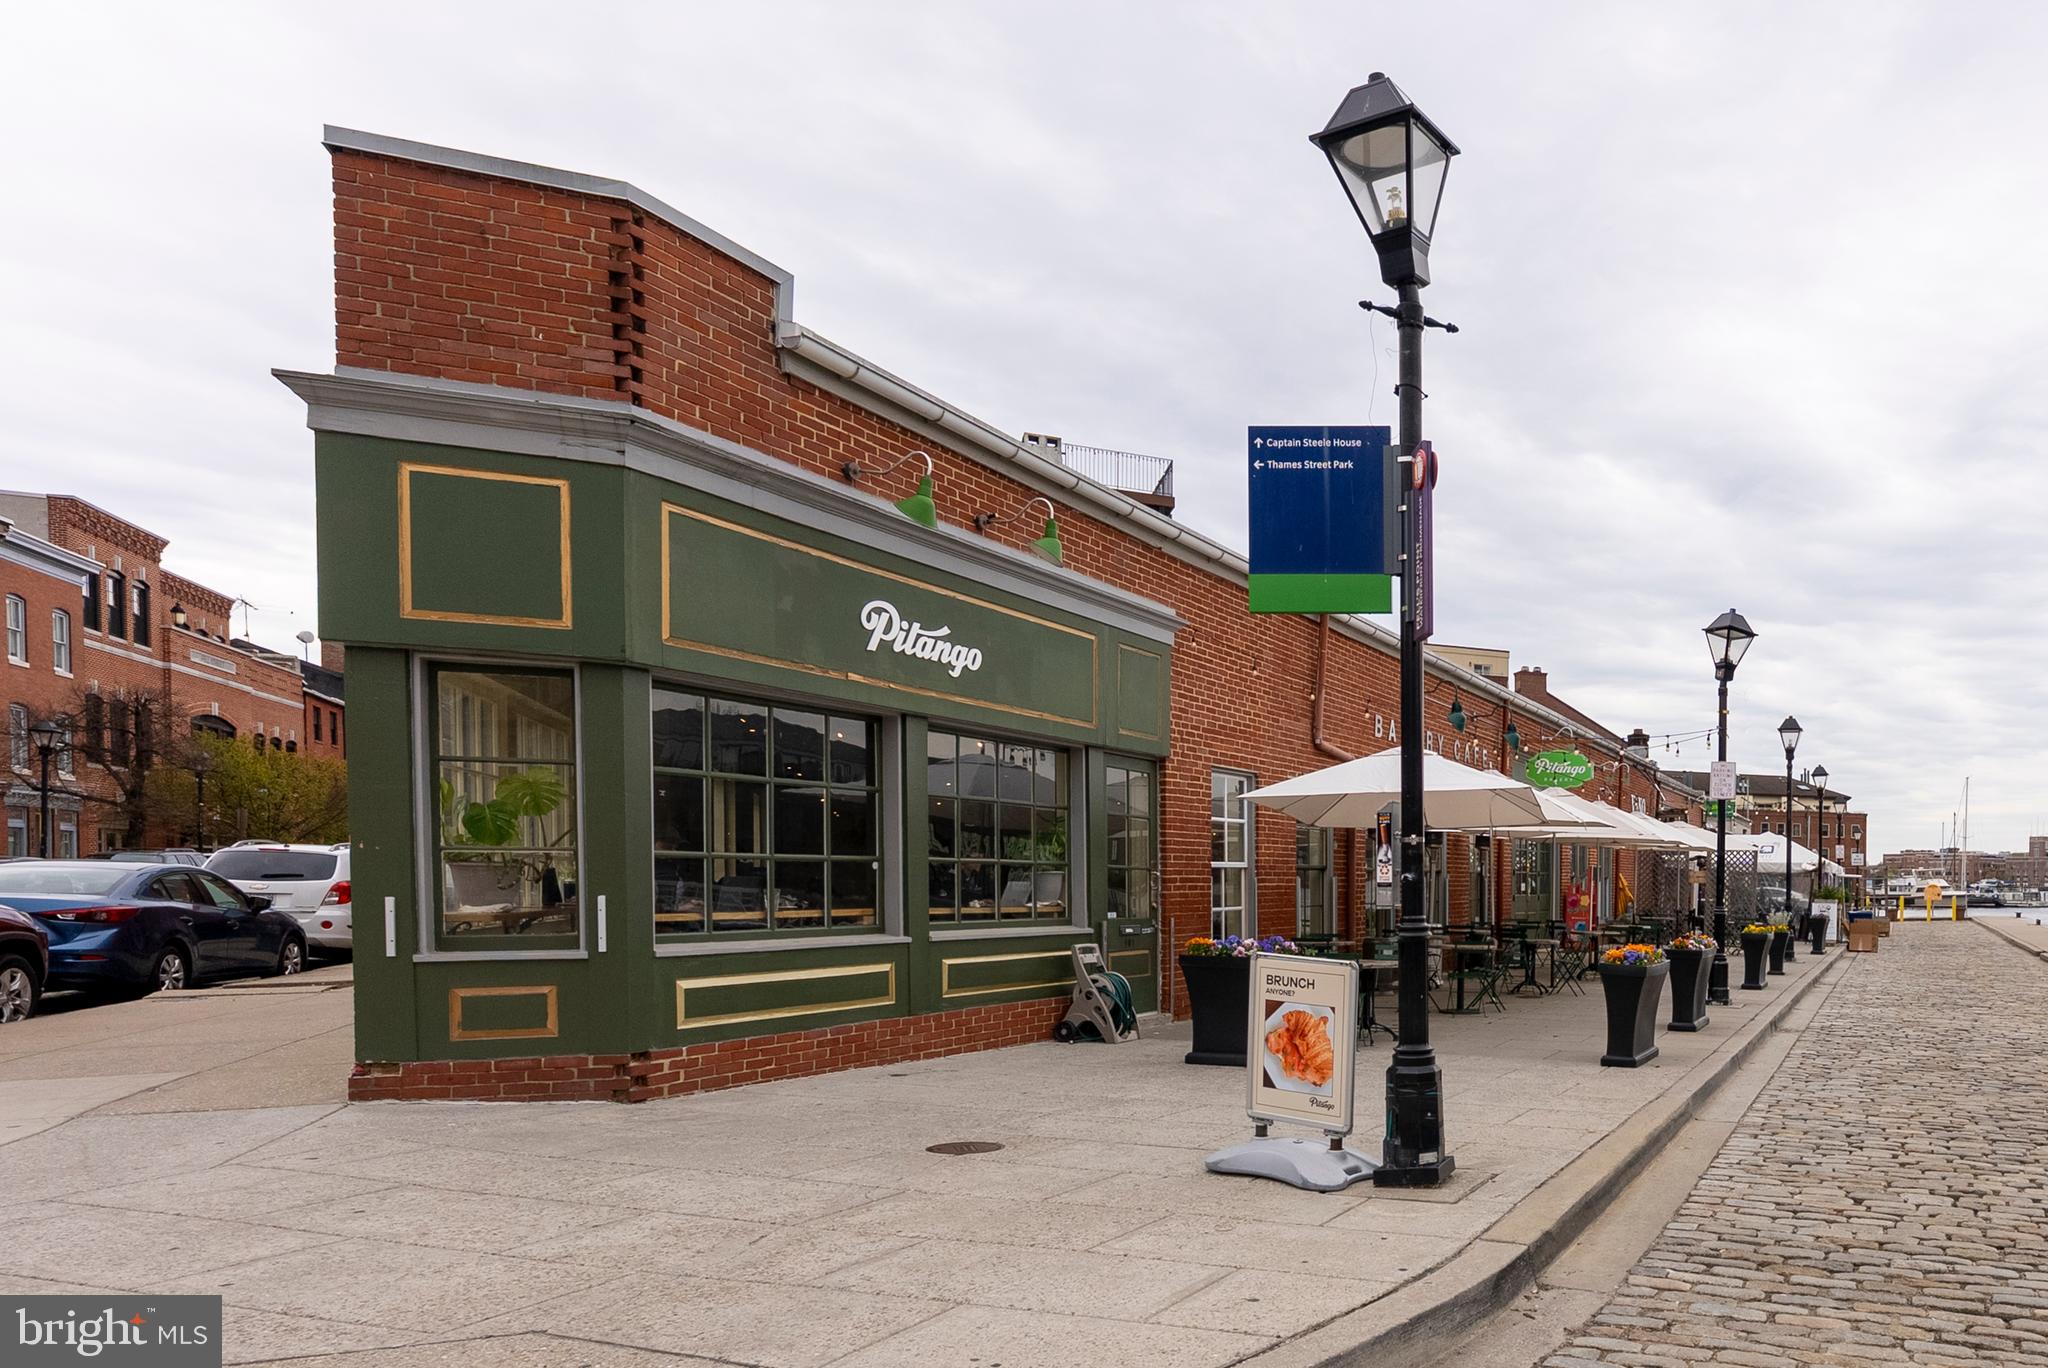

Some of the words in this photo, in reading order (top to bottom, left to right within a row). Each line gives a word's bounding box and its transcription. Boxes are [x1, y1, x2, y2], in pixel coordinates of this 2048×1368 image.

[1266, 438, 1301, 449] Captain
[1302, 438, 1332, 447] Steele
[1333, 438, 1362, 447] House
[1267, 460, 1303, 469] Thames
[1303, 460, 1332, 469] Street
[1333, 460, 1354, 469] Park
[860, 600, 983, 678] Pitango
[1374, 714, 1444, 754] BARY
[1454, 739, 1488, 768] CAFE
[1534, 758, 1585, 777] Pitango
[1266, 974, 1315, 989] BRUNCH
[1265, 988, 1296, 997] ANYONE?
[1309, 1096, 1335, 1111] Pitango
